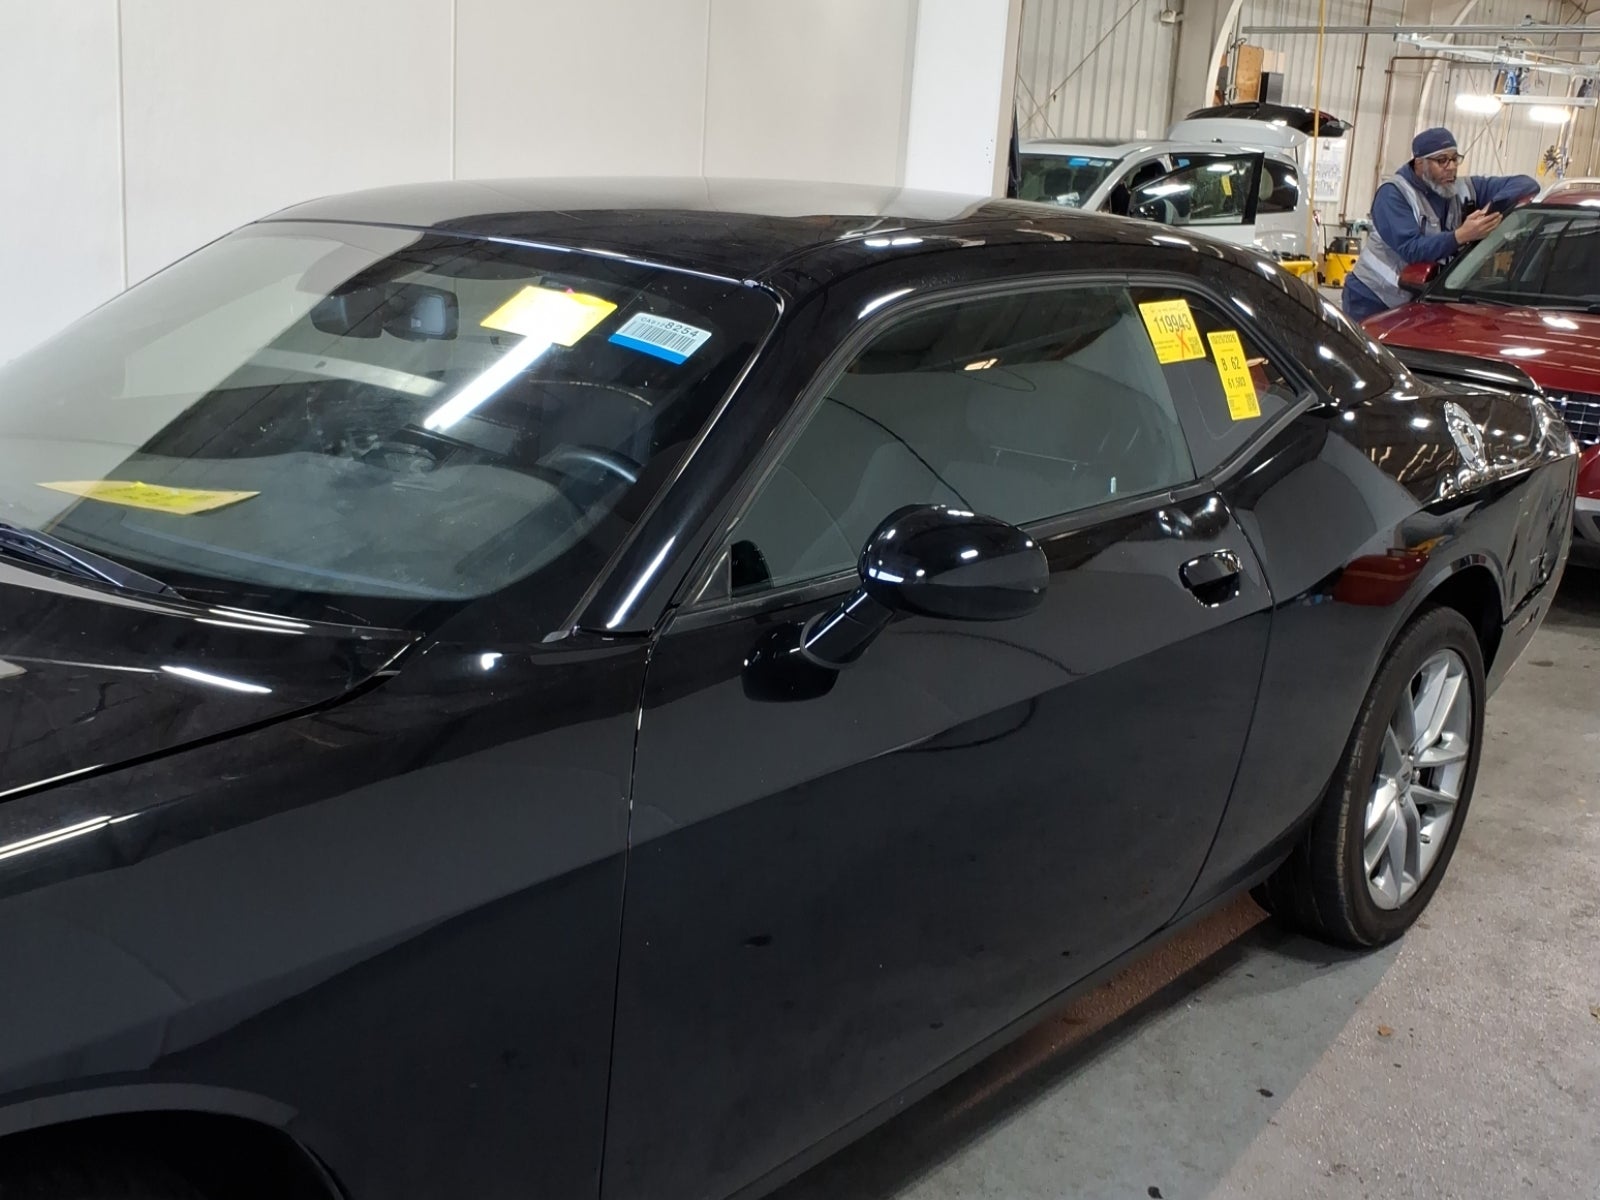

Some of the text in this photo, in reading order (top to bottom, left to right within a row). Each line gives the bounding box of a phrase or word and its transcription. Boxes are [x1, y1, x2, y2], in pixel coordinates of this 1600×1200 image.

[665, 322, 699, 337] 8254
[1153, 313, 1192, 335] 119943
[1221, 356, 1241, 371] B 62
